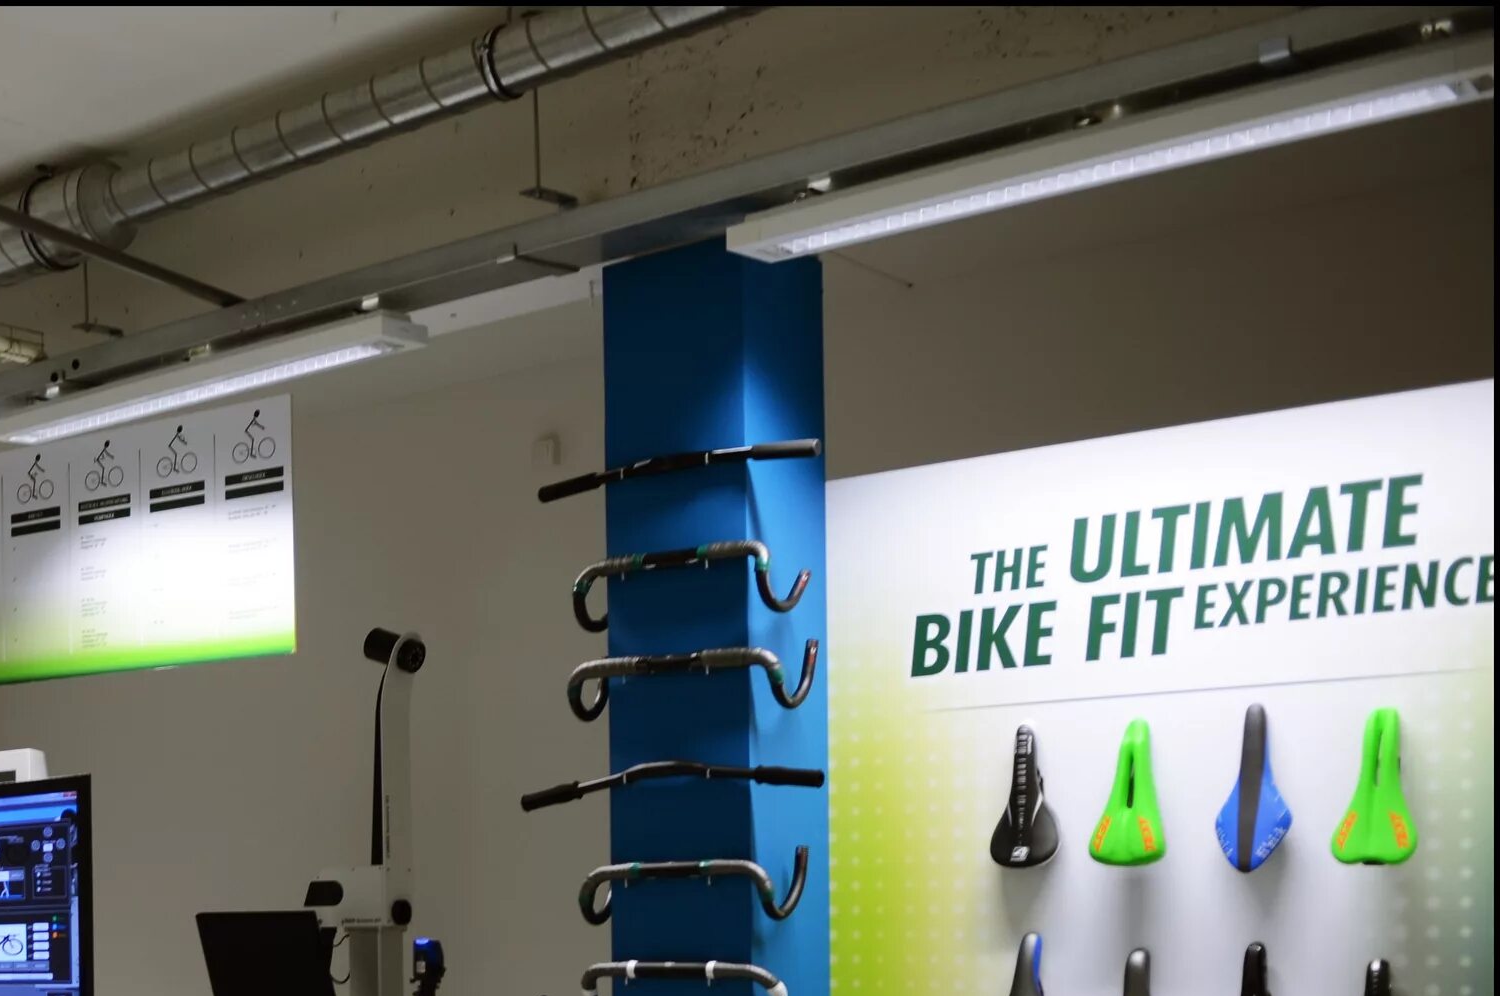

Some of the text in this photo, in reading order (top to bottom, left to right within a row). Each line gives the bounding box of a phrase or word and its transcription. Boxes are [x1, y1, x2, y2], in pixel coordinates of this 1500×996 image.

[970, 473, 1423, 594] THE ULTIMATE
[910, 555, 1494, 677] BIKE FIT EXPERIENCE
